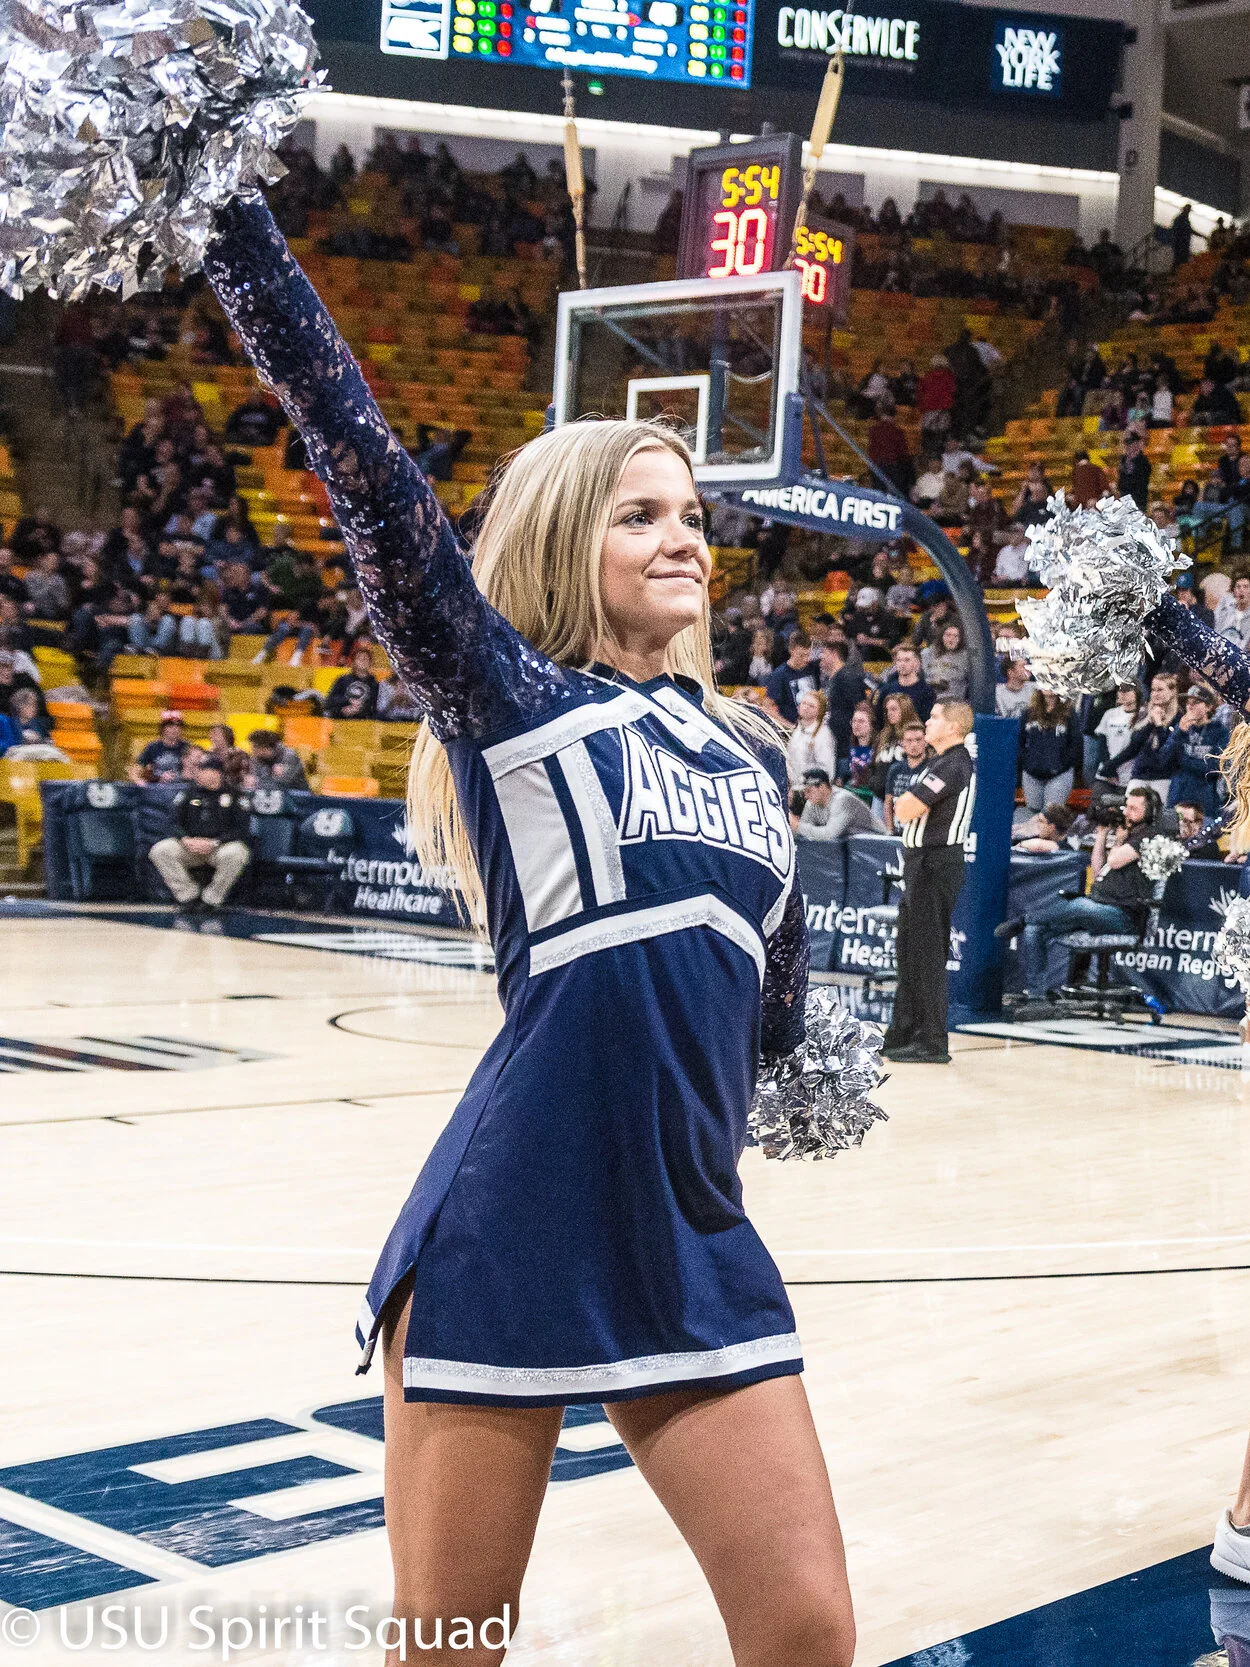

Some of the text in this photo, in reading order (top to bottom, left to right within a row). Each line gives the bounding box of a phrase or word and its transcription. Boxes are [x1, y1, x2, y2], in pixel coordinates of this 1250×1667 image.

[778, 6, 921, 61] CONSERVICE
[1004, 27, 1059, 51] NEW
[995, 42, 1061, 74] YORK
[1001, 65, 1055, 91] LIFE
[721, 164, 780, 208] 5:54
[708, 207, 769, 279] 30
[795, 225, 843, 264] 5:54
[741, 485, 902, 531] AMERICA FIRST
[618, 724, 795, 880] AGGIES
[354, 885, 443, 915] Healthcare
